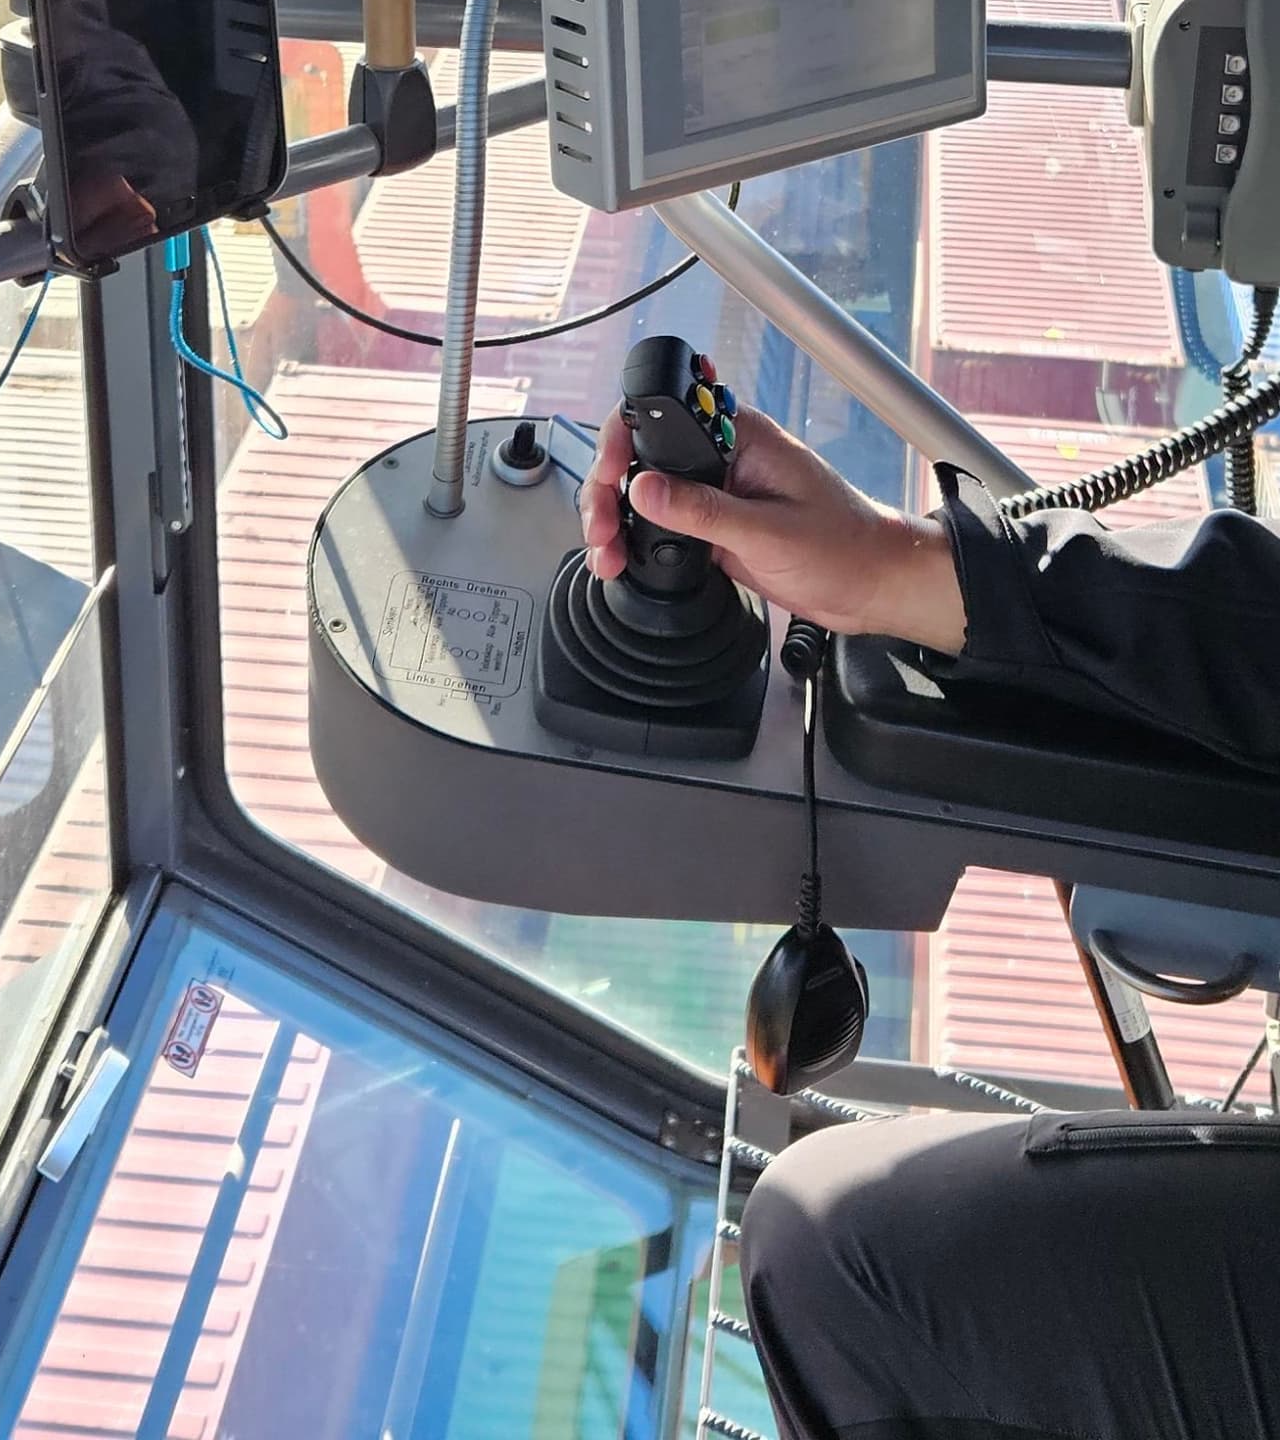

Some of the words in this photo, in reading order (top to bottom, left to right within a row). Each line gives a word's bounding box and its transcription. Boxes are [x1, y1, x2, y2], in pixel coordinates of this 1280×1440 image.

[420, 575, 460, 590] Rechts
[466, 582, 508, 597] Drehen
[406, 671, 436, 686] Links
[443, 676, 487, 694] Drehen
